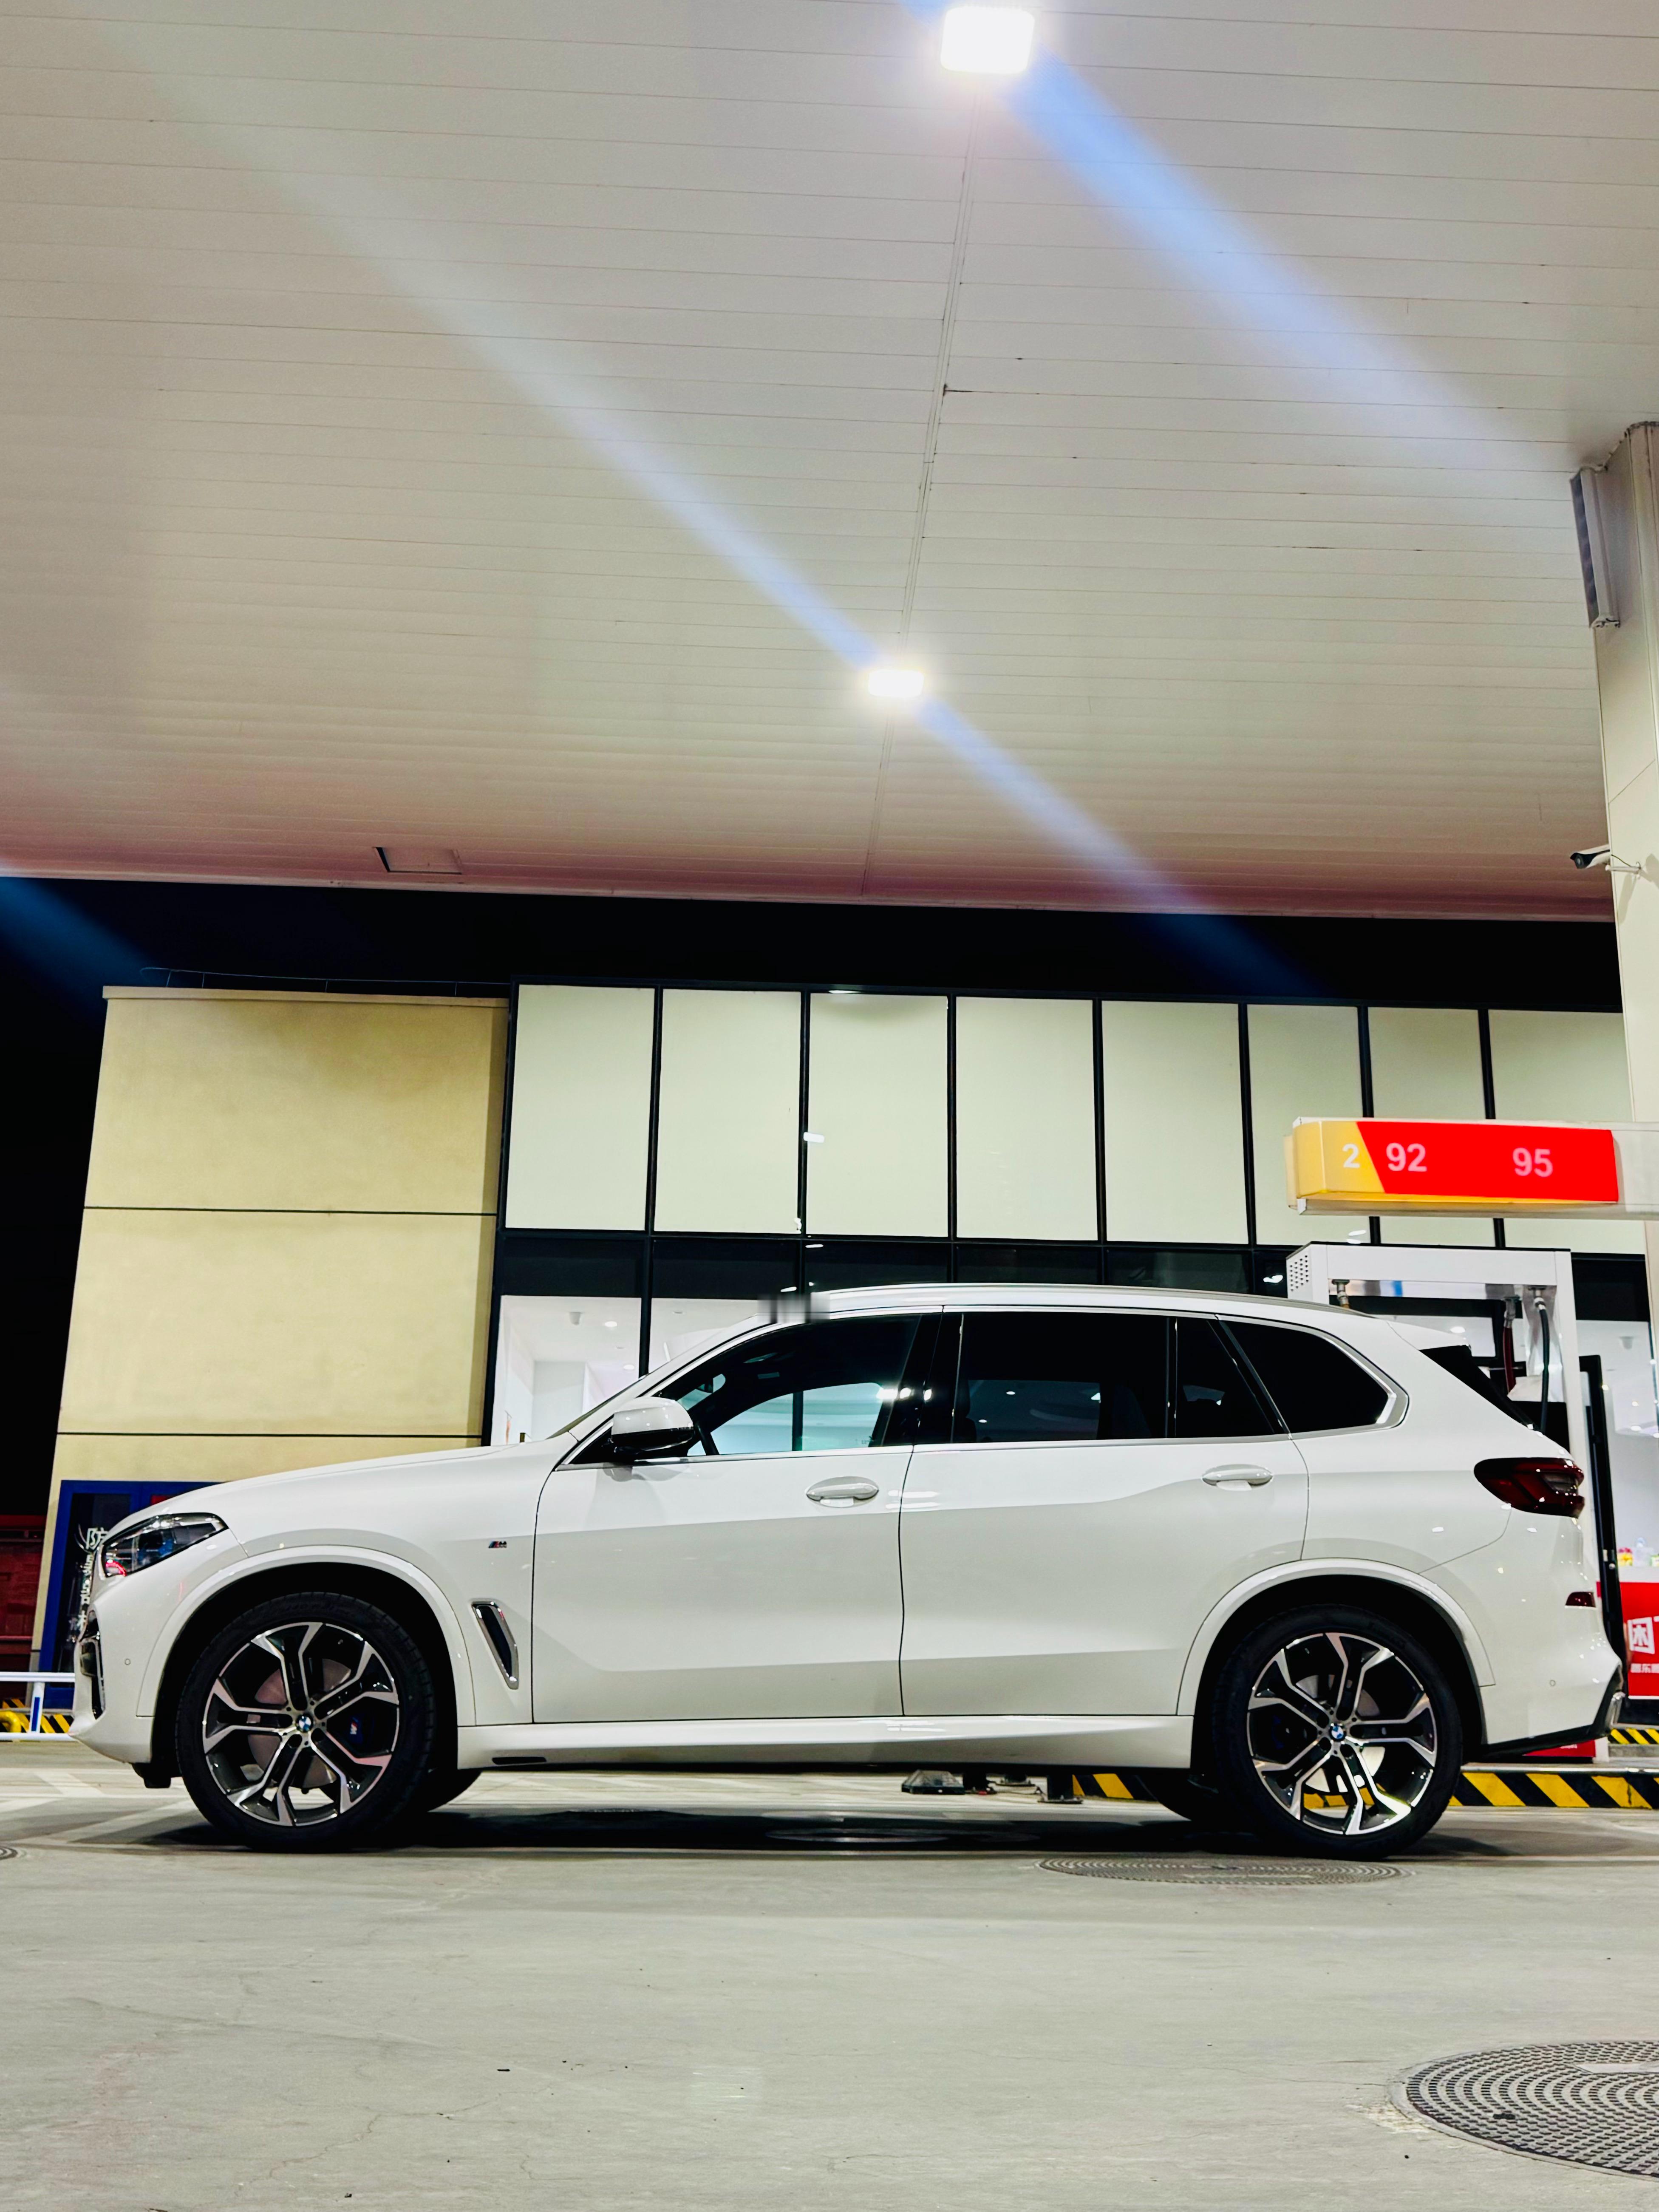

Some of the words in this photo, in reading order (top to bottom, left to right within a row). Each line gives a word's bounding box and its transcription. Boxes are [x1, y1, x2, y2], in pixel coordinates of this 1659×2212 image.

[1342, 1143, 1360, 1168] 2
[1386, 1142, 1427, 1172] 92
[1512, 1147, 1553, 1178] 95
[1627, 1615, 1659, 1654] 困
